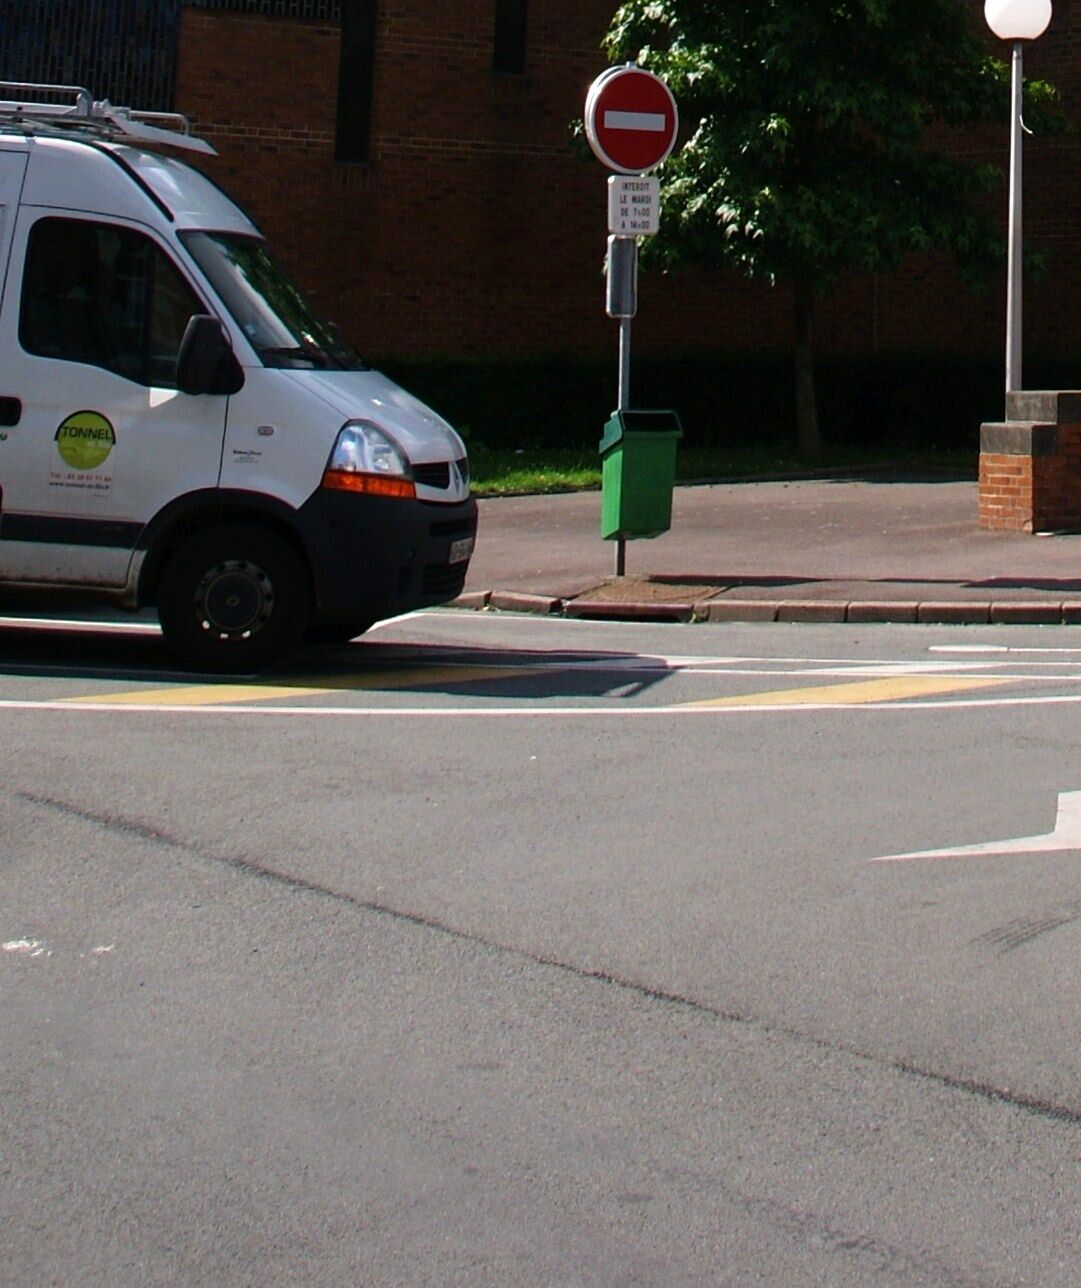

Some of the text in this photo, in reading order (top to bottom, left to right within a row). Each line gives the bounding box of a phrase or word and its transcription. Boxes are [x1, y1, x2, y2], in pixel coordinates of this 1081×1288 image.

[621, 182, 650, 192] INTERDIT
[620, 195, 652, 204] LE MARDI
[620, 207, 629, 217] DE
[621, 220, 626, 229] A
[62, 426, 112, 440] TONNEL
